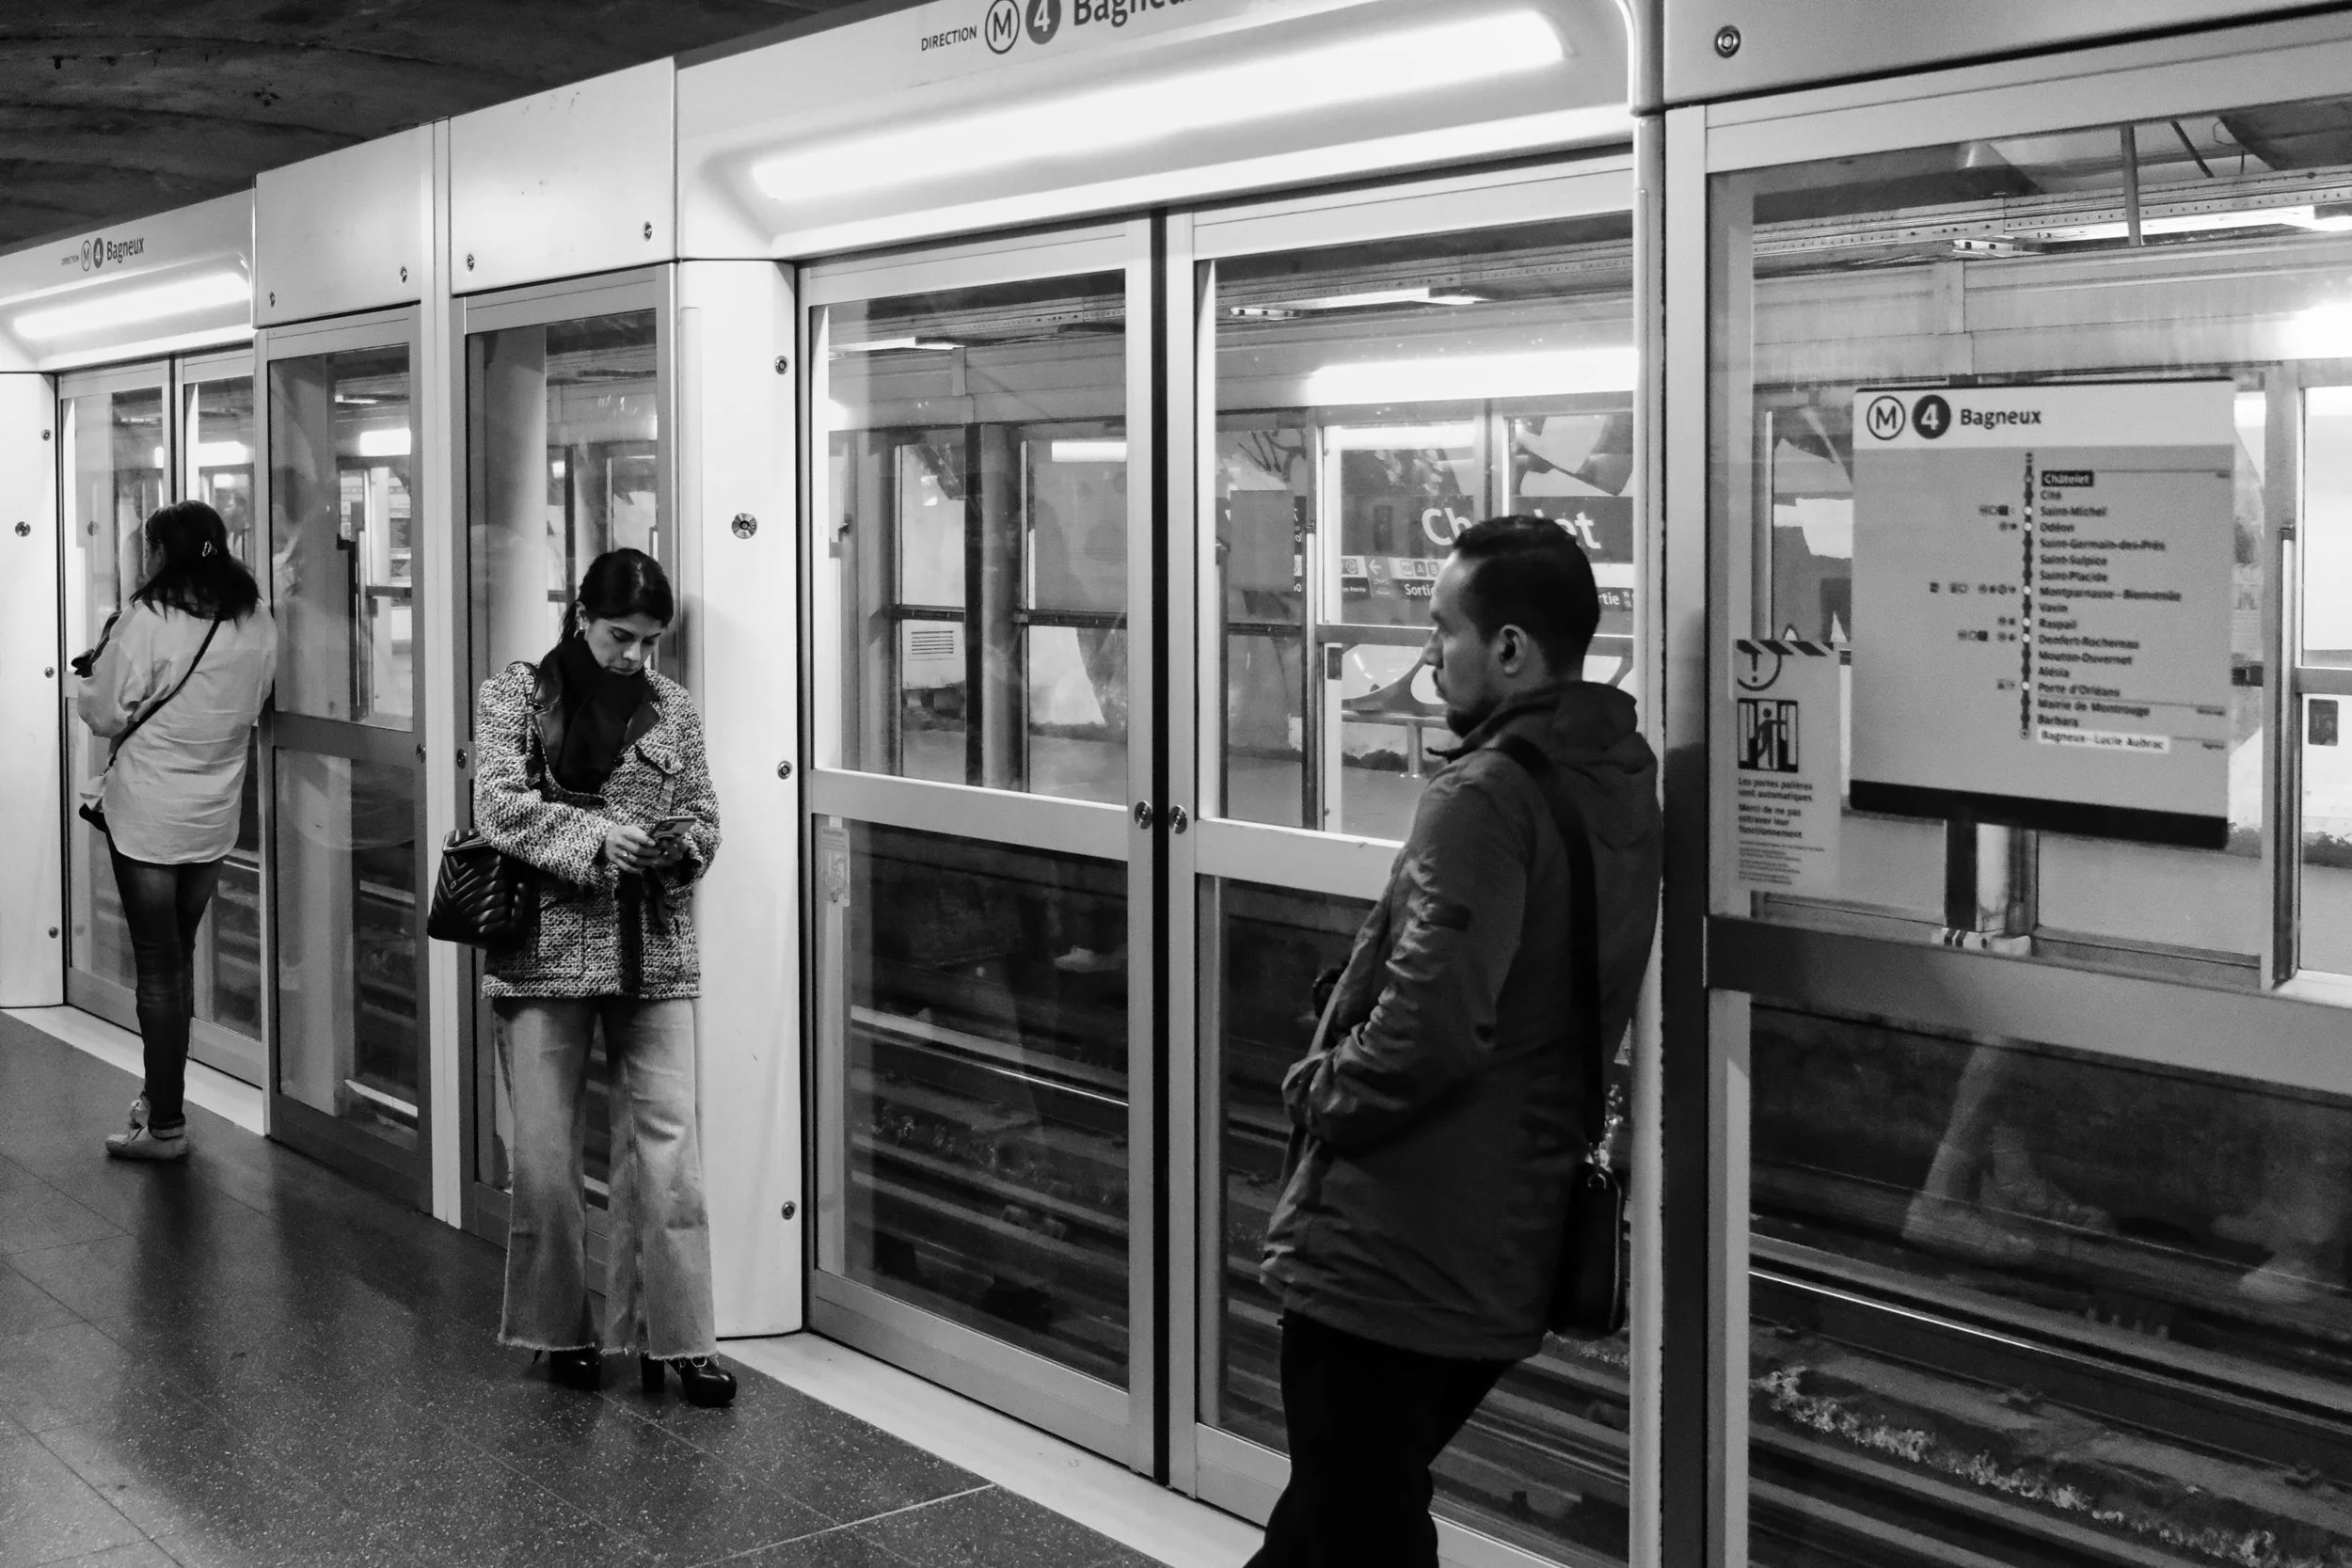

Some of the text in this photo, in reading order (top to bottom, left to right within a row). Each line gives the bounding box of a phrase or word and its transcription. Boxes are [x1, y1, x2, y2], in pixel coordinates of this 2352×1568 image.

[921, 25, 977, 51] DIRECTION
[106, 237, 144, 263] Bagneux
[1961, 408, 2042, 430] Bagneux
